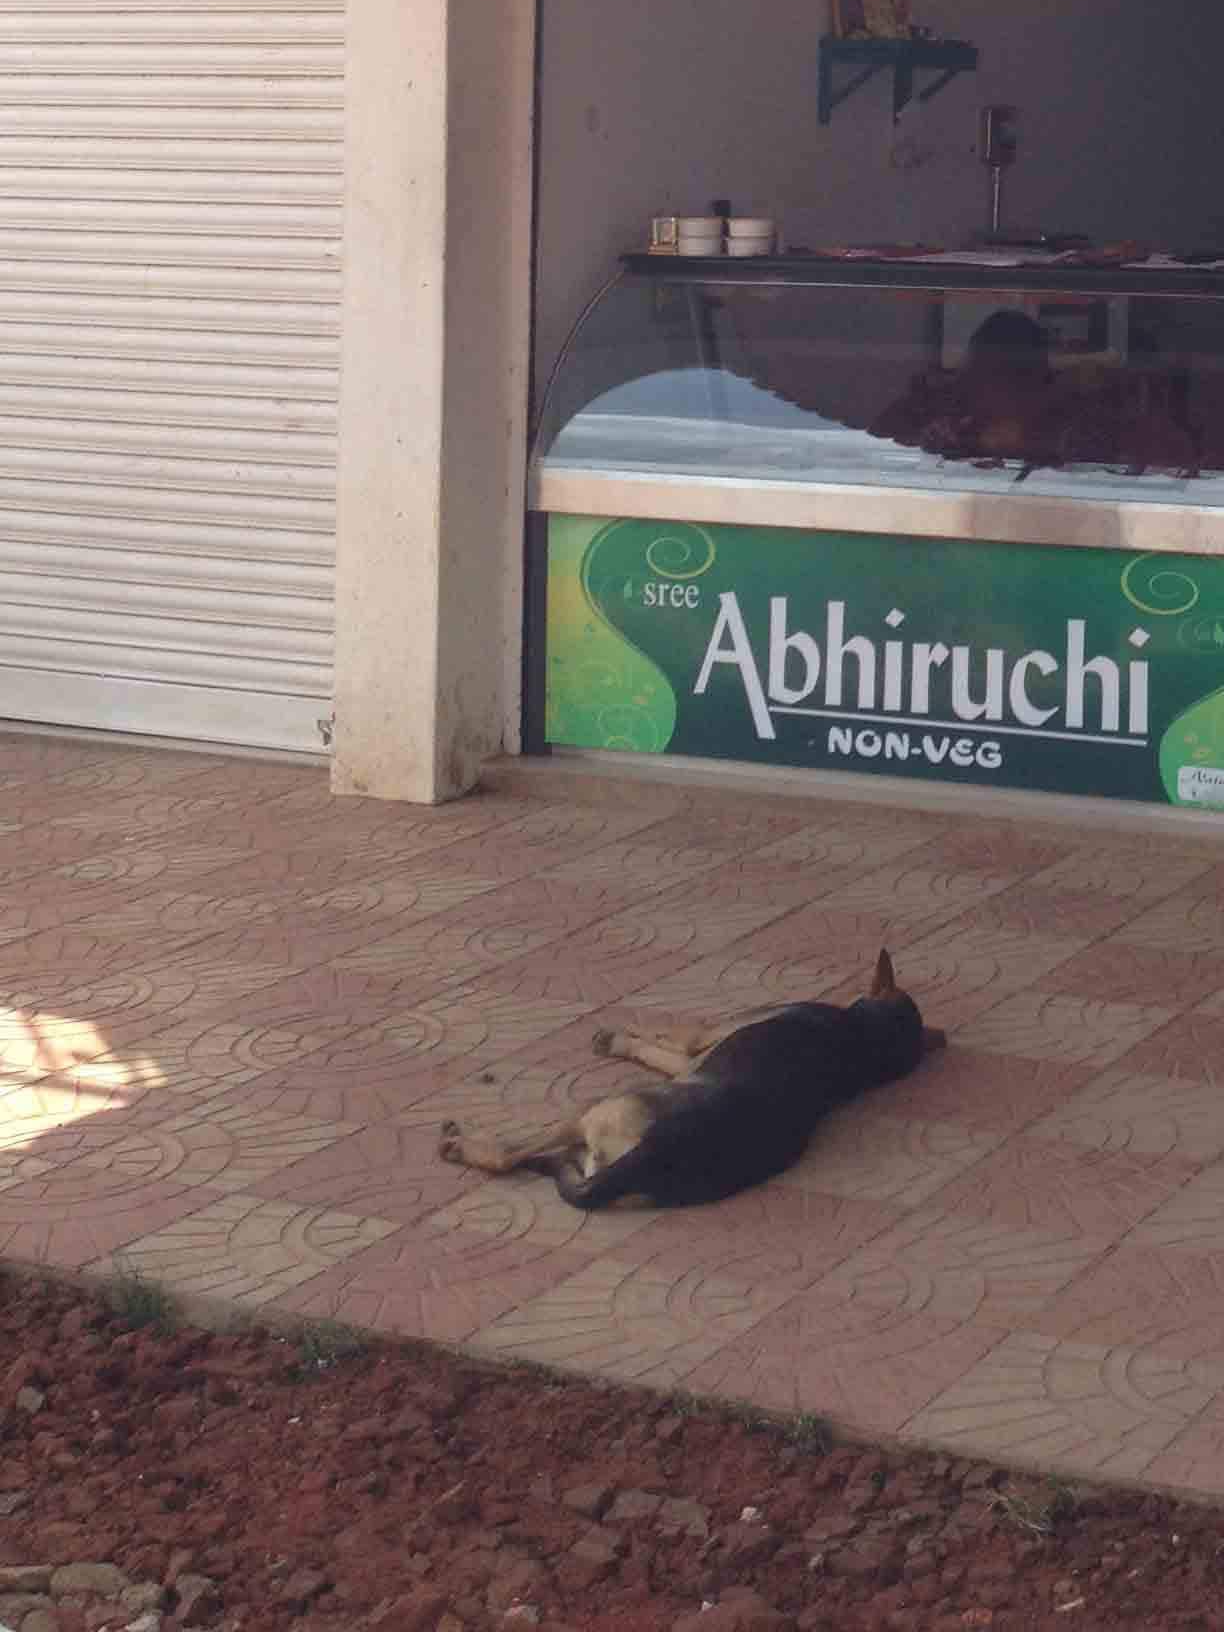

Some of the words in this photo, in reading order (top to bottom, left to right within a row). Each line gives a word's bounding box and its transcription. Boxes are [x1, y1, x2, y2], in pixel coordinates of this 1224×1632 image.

[643, 582, 700, 610] sree
[693, 591, 1150, 741] Abhiruchi
[828, 726, 1003, 770] NON-VEG
